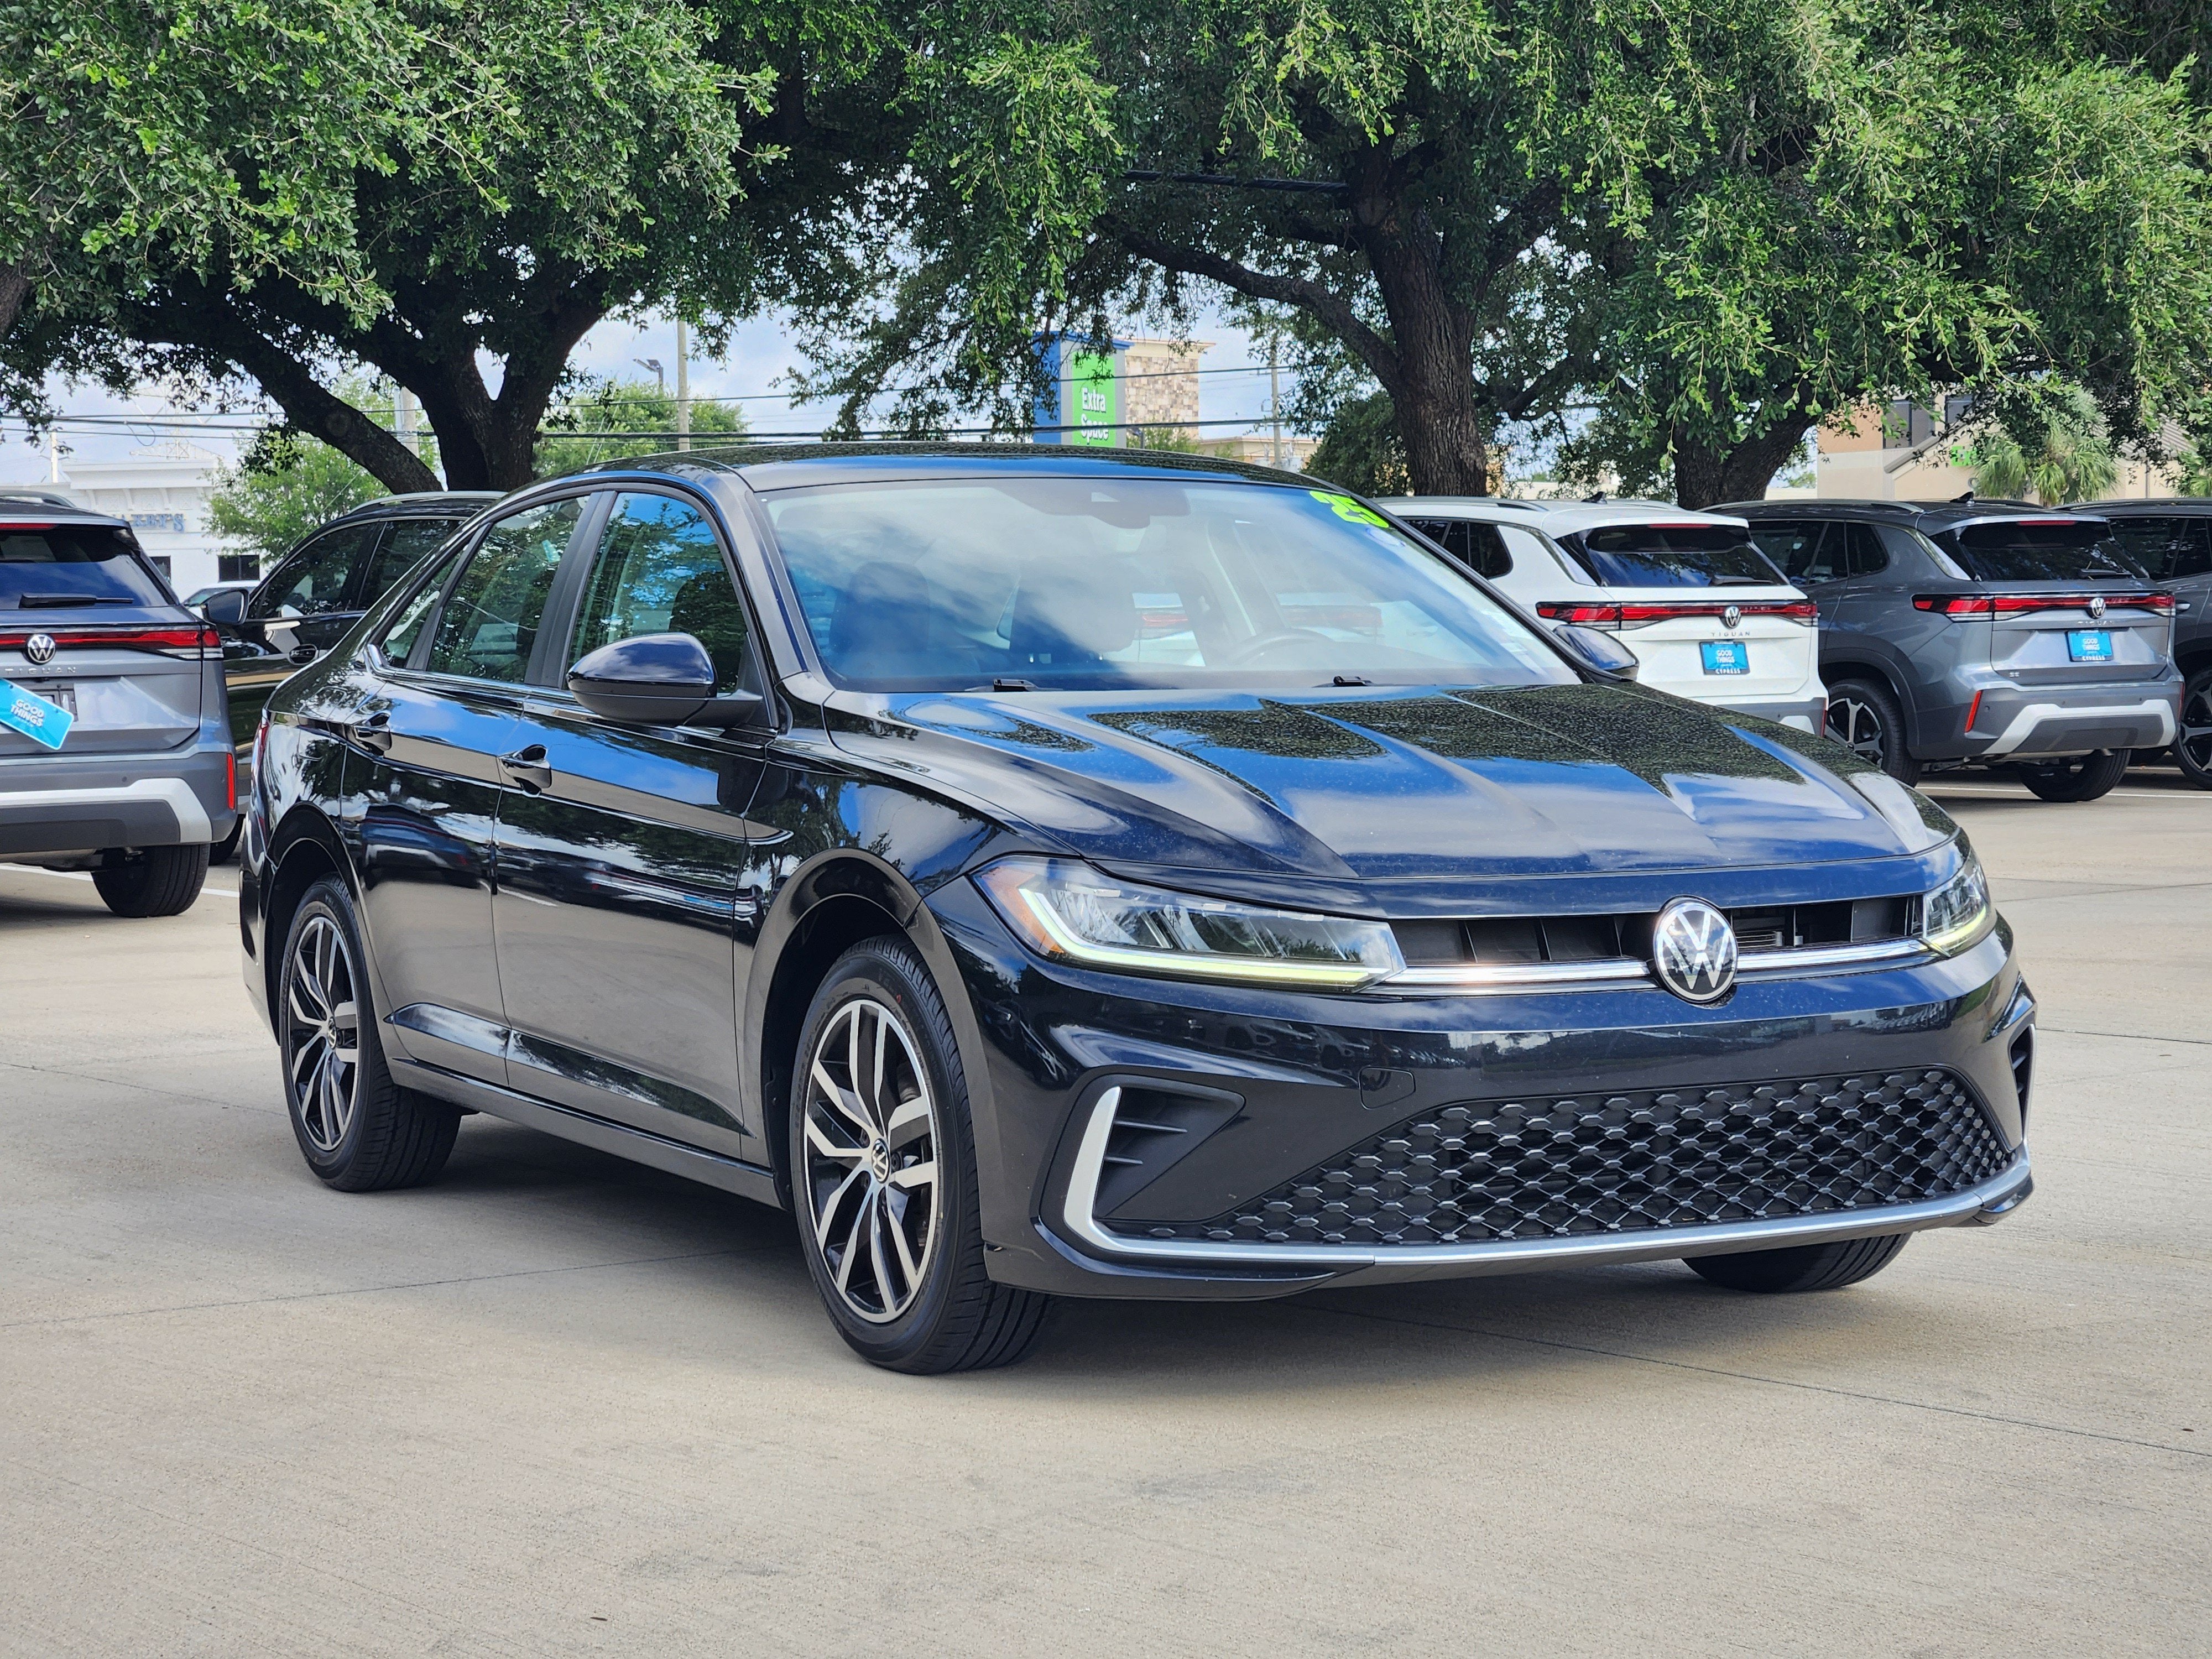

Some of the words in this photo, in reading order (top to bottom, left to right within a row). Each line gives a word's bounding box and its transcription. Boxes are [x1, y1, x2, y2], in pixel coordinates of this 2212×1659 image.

[1082, 387, 1106, 413] Extra
[1081, 414, 1108, 444] Space
[1310, 491, 1389, 528] 25
[5, 666, 76, 675] TIGUAN
[11, 705, 43, 727] THINGS
[16, 699, 44, 718] GOOD
[1656, 902, 1737, 1000] VW
